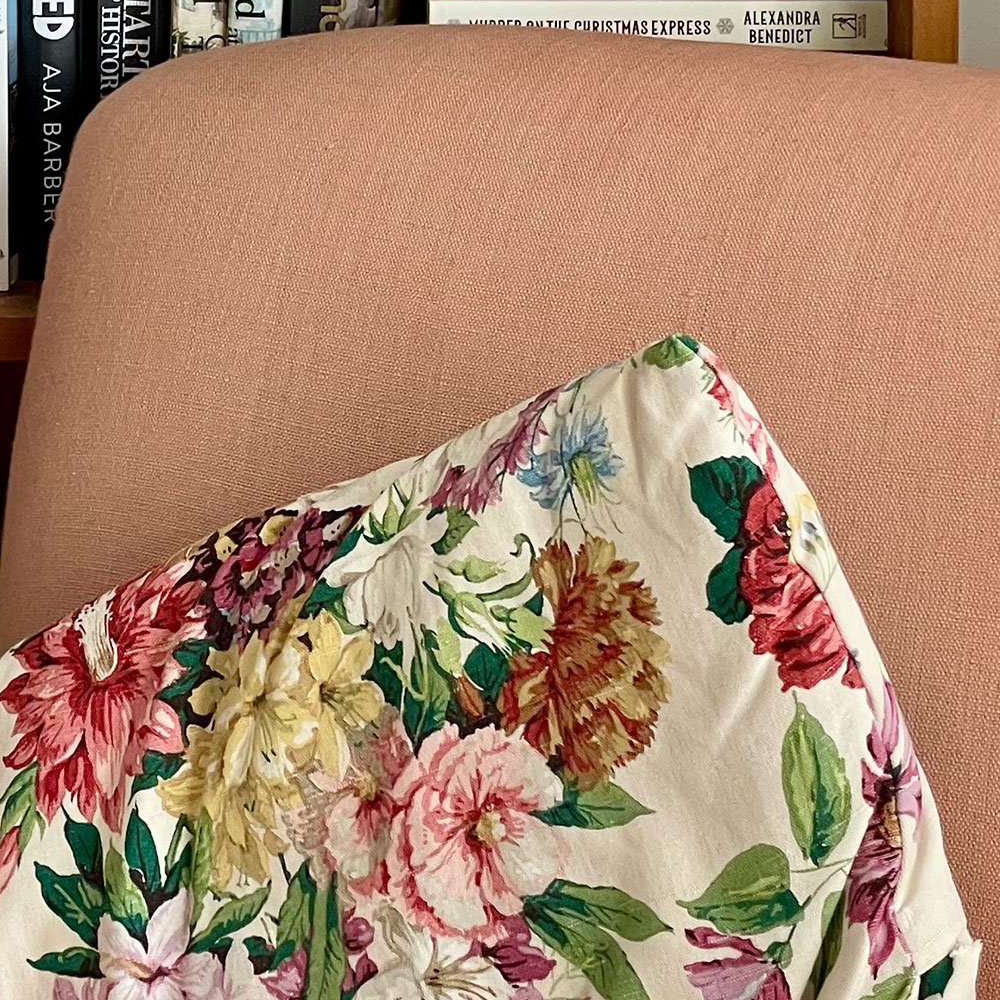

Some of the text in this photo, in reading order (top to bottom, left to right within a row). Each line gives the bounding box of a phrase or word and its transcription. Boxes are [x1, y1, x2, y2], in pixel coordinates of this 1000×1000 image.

[652, 11, 820, 35] EXPRESS ALEXANDRA
[749, 29, 812, 43] BENEDICT
[42, 64, 61, 111] AJA
[42, 123, 61, 222] BARBER
